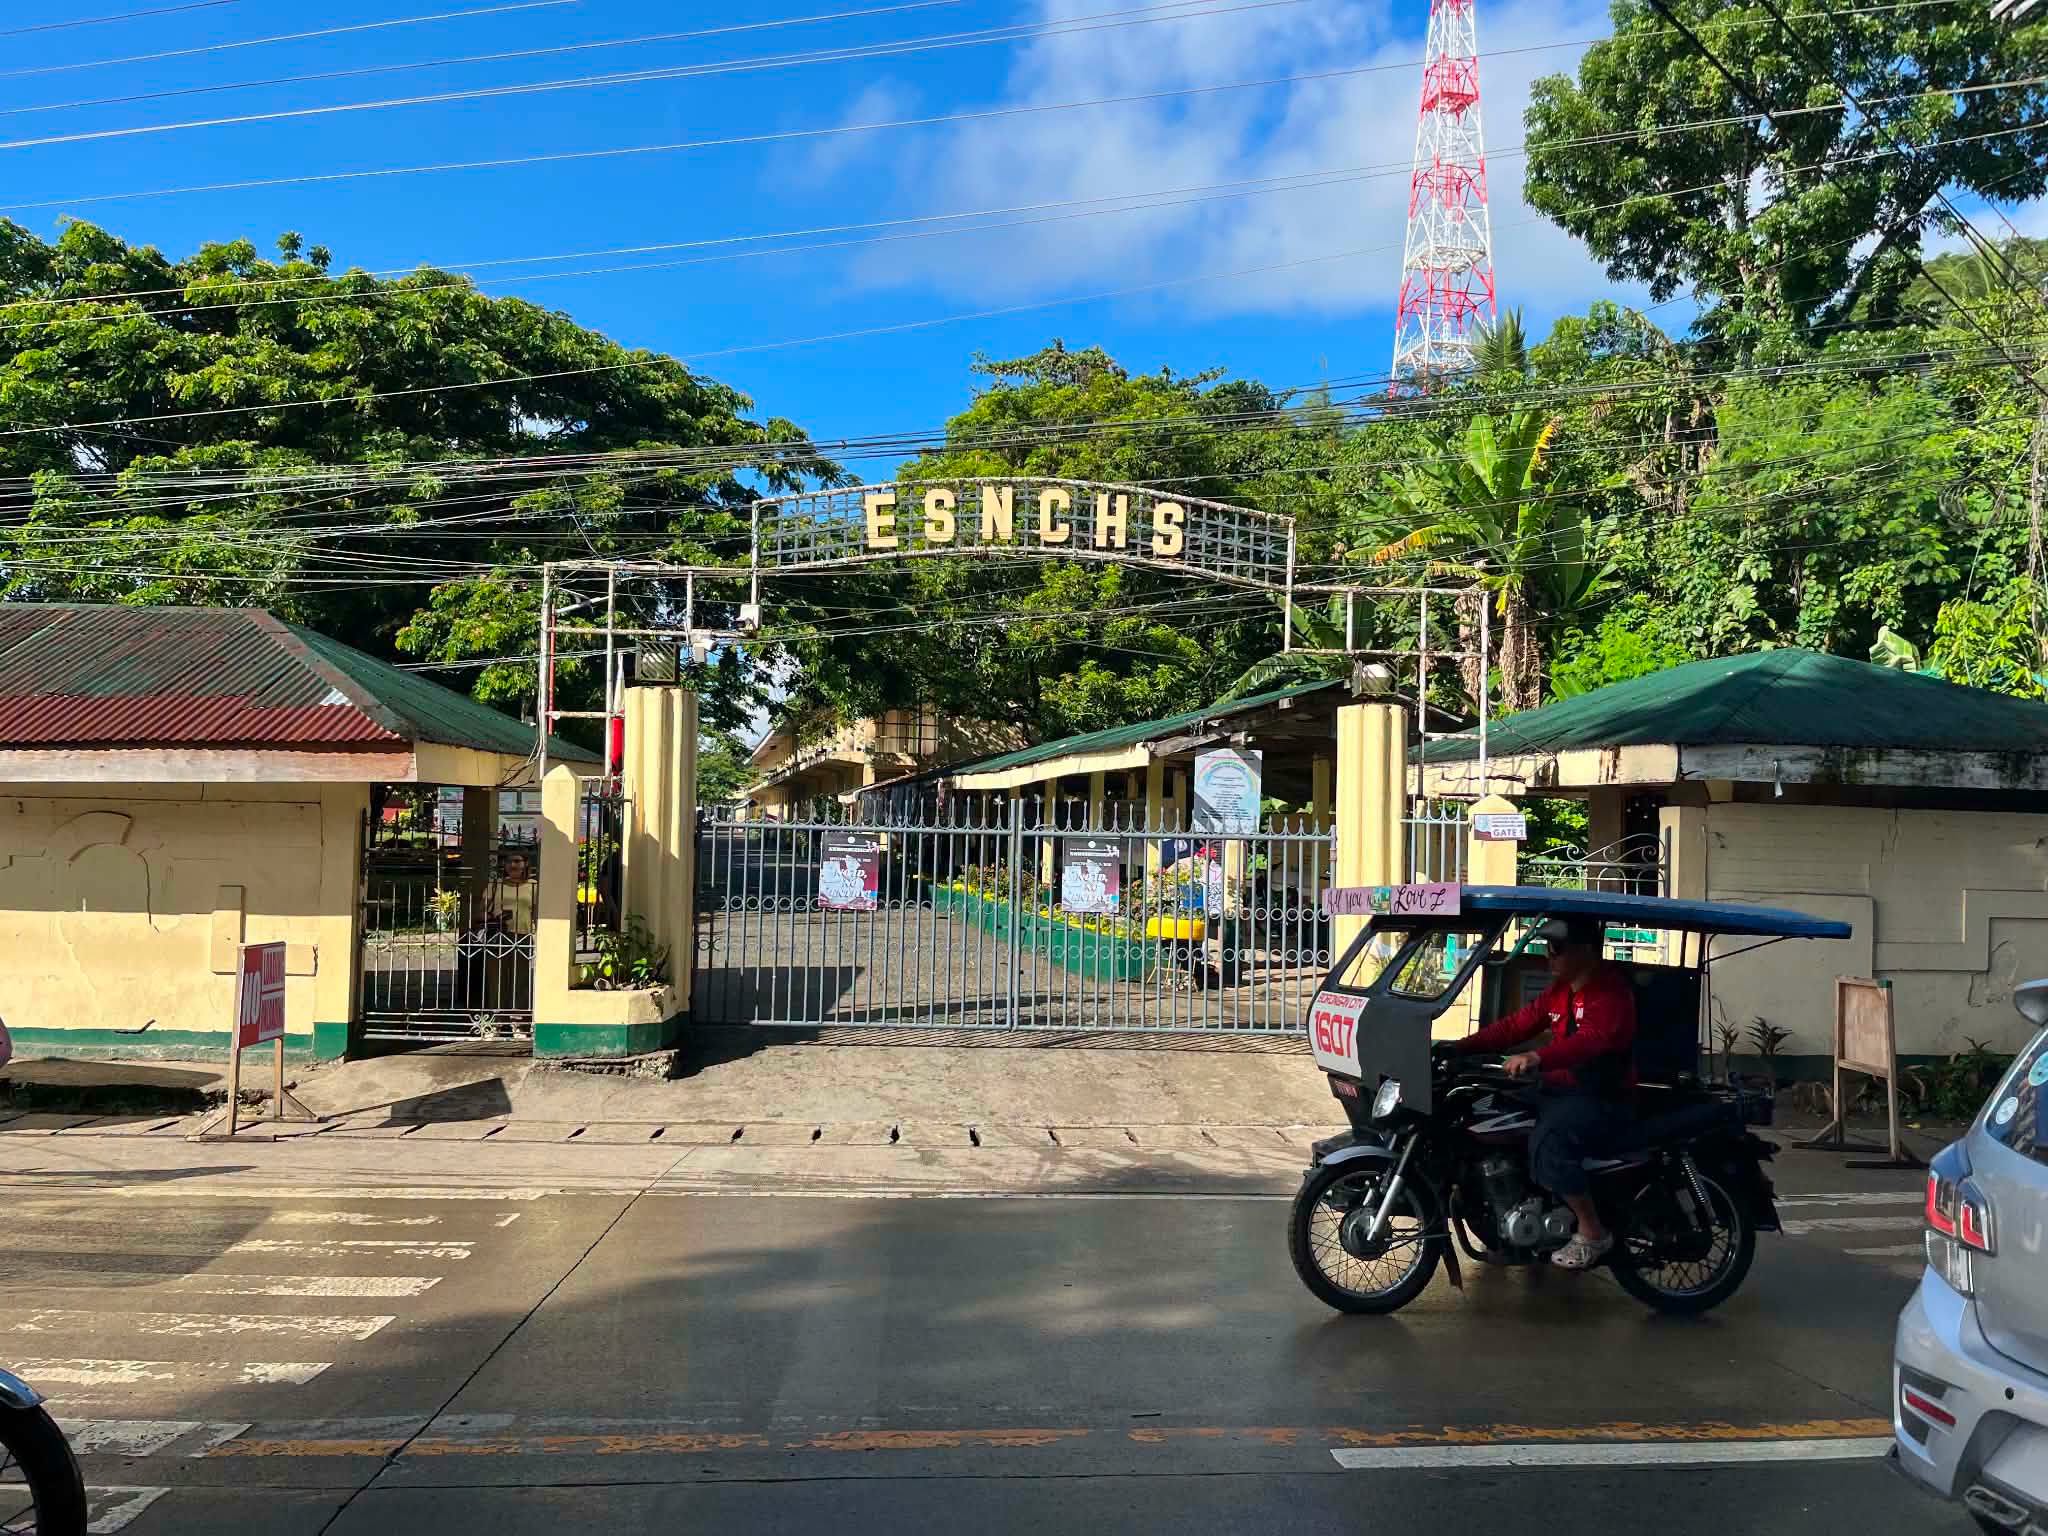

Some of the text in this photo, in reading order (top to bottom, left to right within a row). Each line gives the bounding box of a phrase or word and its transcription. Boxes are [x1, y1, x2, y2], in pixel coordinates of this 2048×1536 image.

[865, 486, 1185, 556] ESNCHS
[1493, 829, 1516, 837] GATE
[1394, 885, 1427, 913] Love
[242, 970, 260, 1025] NO
[1315, 1011, 1355, 1058] 1607
